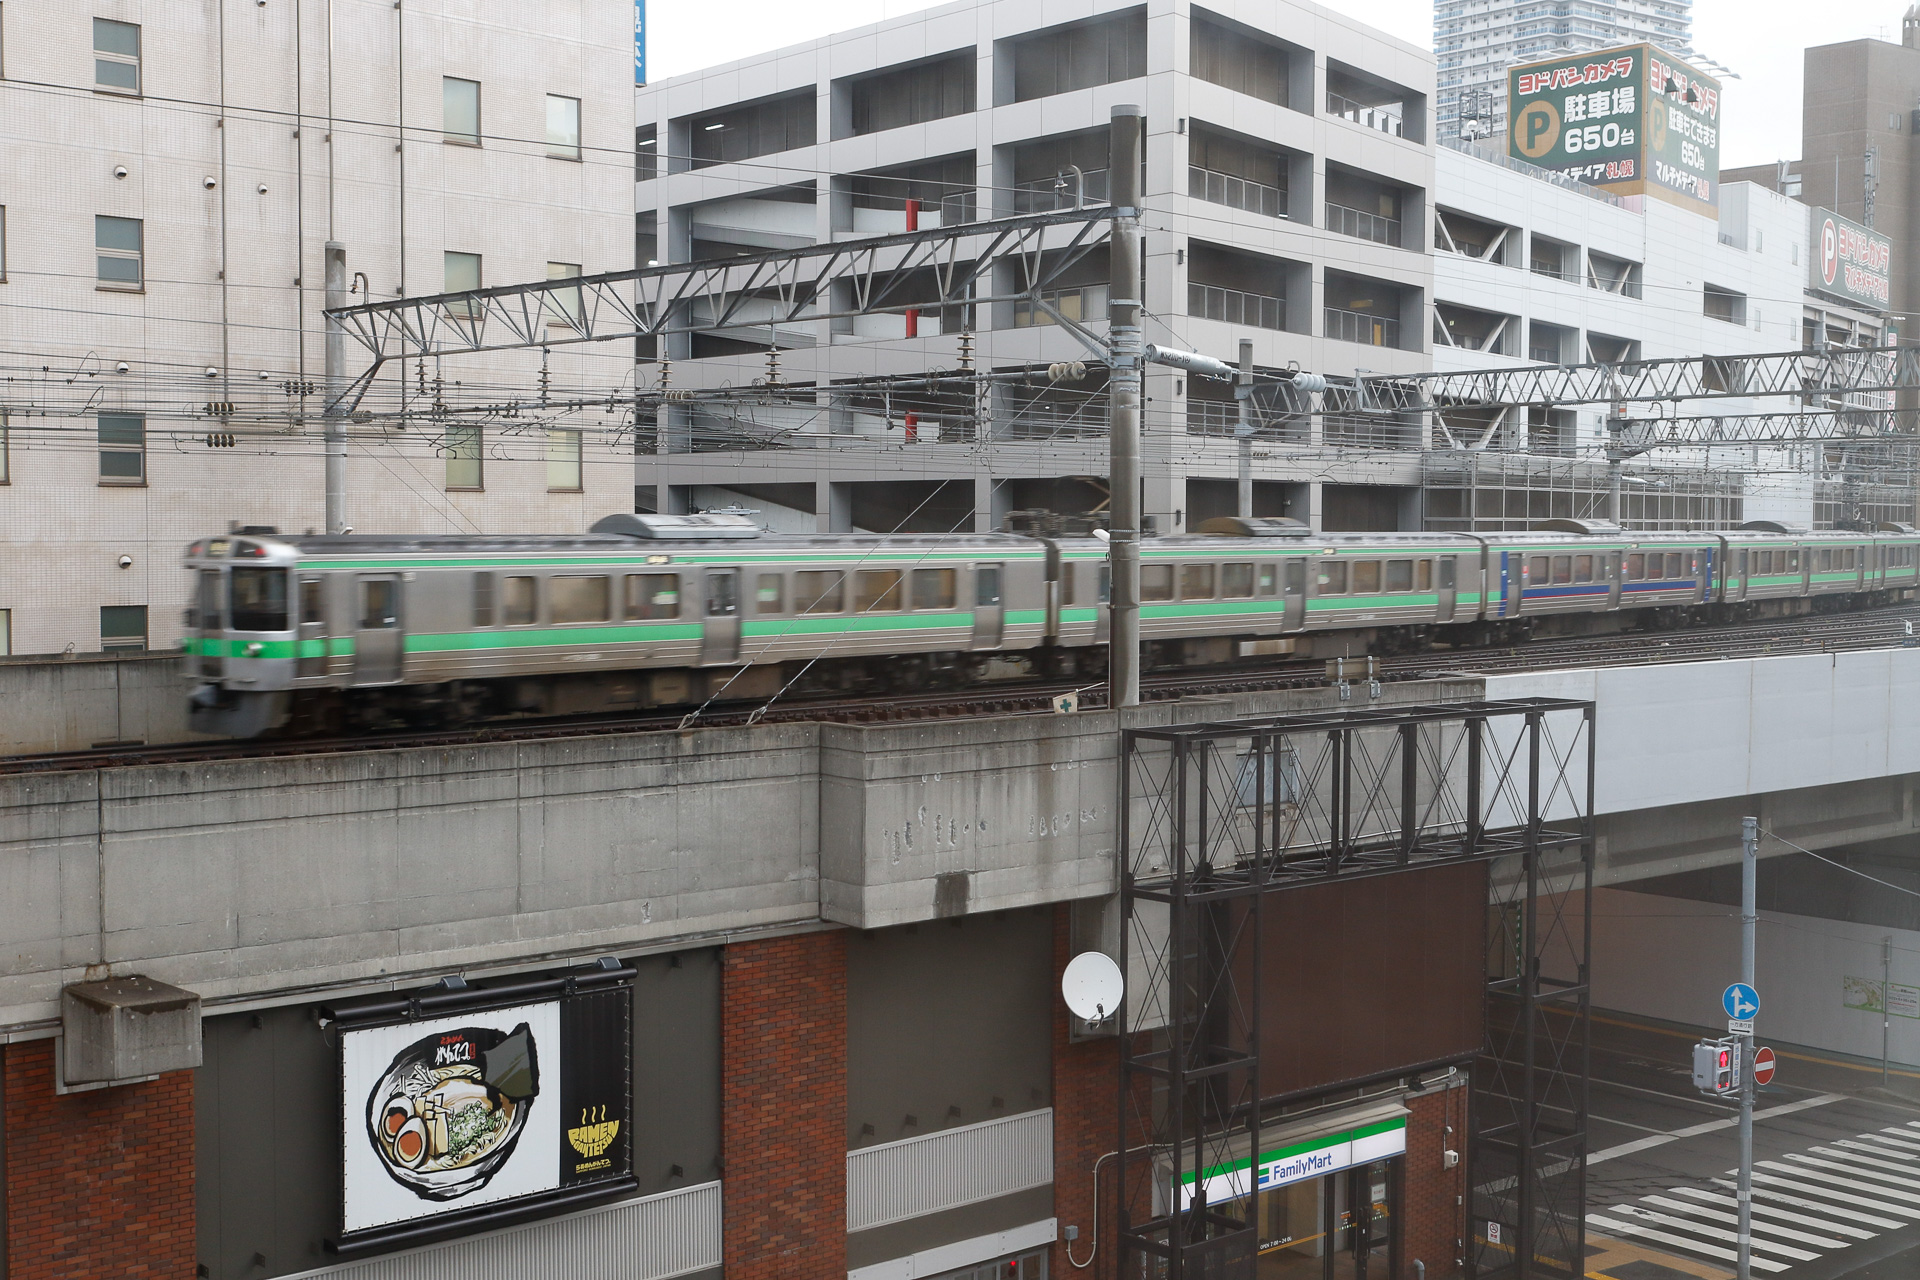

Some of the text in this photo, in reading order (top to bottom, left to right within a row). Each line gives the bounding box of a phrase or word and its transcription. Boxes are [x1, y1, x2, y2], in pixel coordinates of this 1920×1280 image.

[1518, 56, 1633, 95] ヨドバシカメラ
[1564, 86, 1635, 123] 駐車場
[1526, 111, 1550, 150] P
[1564, 122, 1635, 153] 650台
[1668, 106, 1716, 149] 駐車もできます
[1681, 140, 1705, 171] 650台
[1655, 160, 1710, 201] マルチメディア札幌
[1825, 228, 1835, 275] P
[1839, 223, 1889, 275] ヨドバシカメラ
[568, 1120, 620, 1146] RAMEN
[573, 1134, 613, 1158] GANTETSU
[1273, 1152, 1332, 1181] FamilyMart
